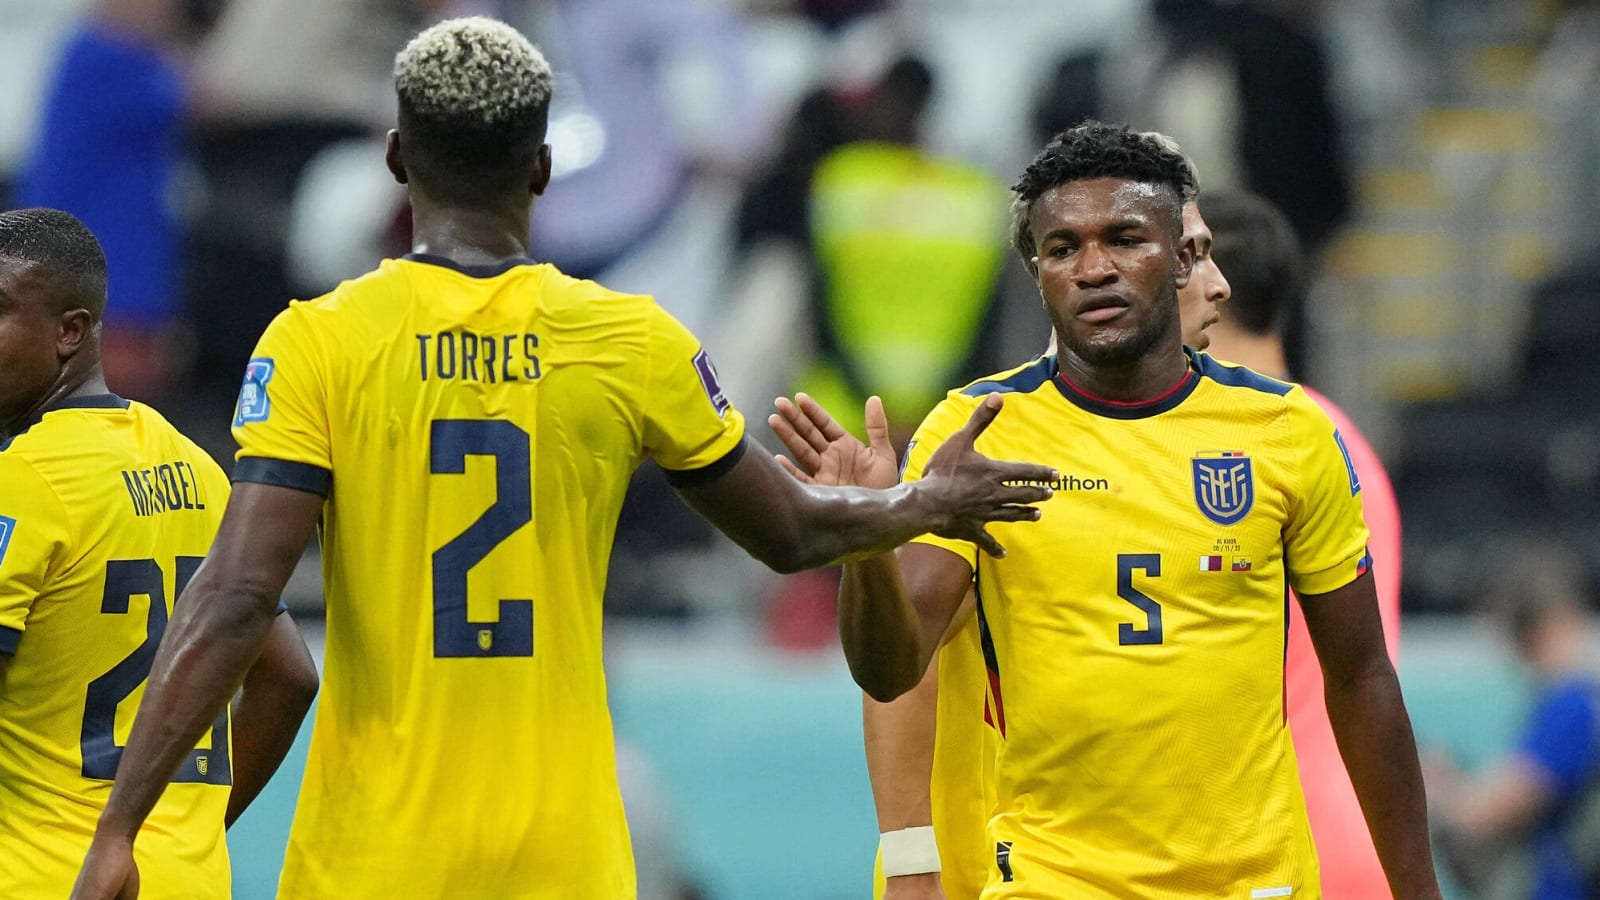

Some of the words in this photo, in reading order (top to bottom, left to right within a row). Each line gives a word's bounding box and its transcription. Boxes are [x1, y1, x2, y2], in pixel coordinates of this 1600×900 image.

[415, 331, 541, 384] TORRES
[430, 419, 534, 658] 2
[1117, 553, 1163, 646] 5
